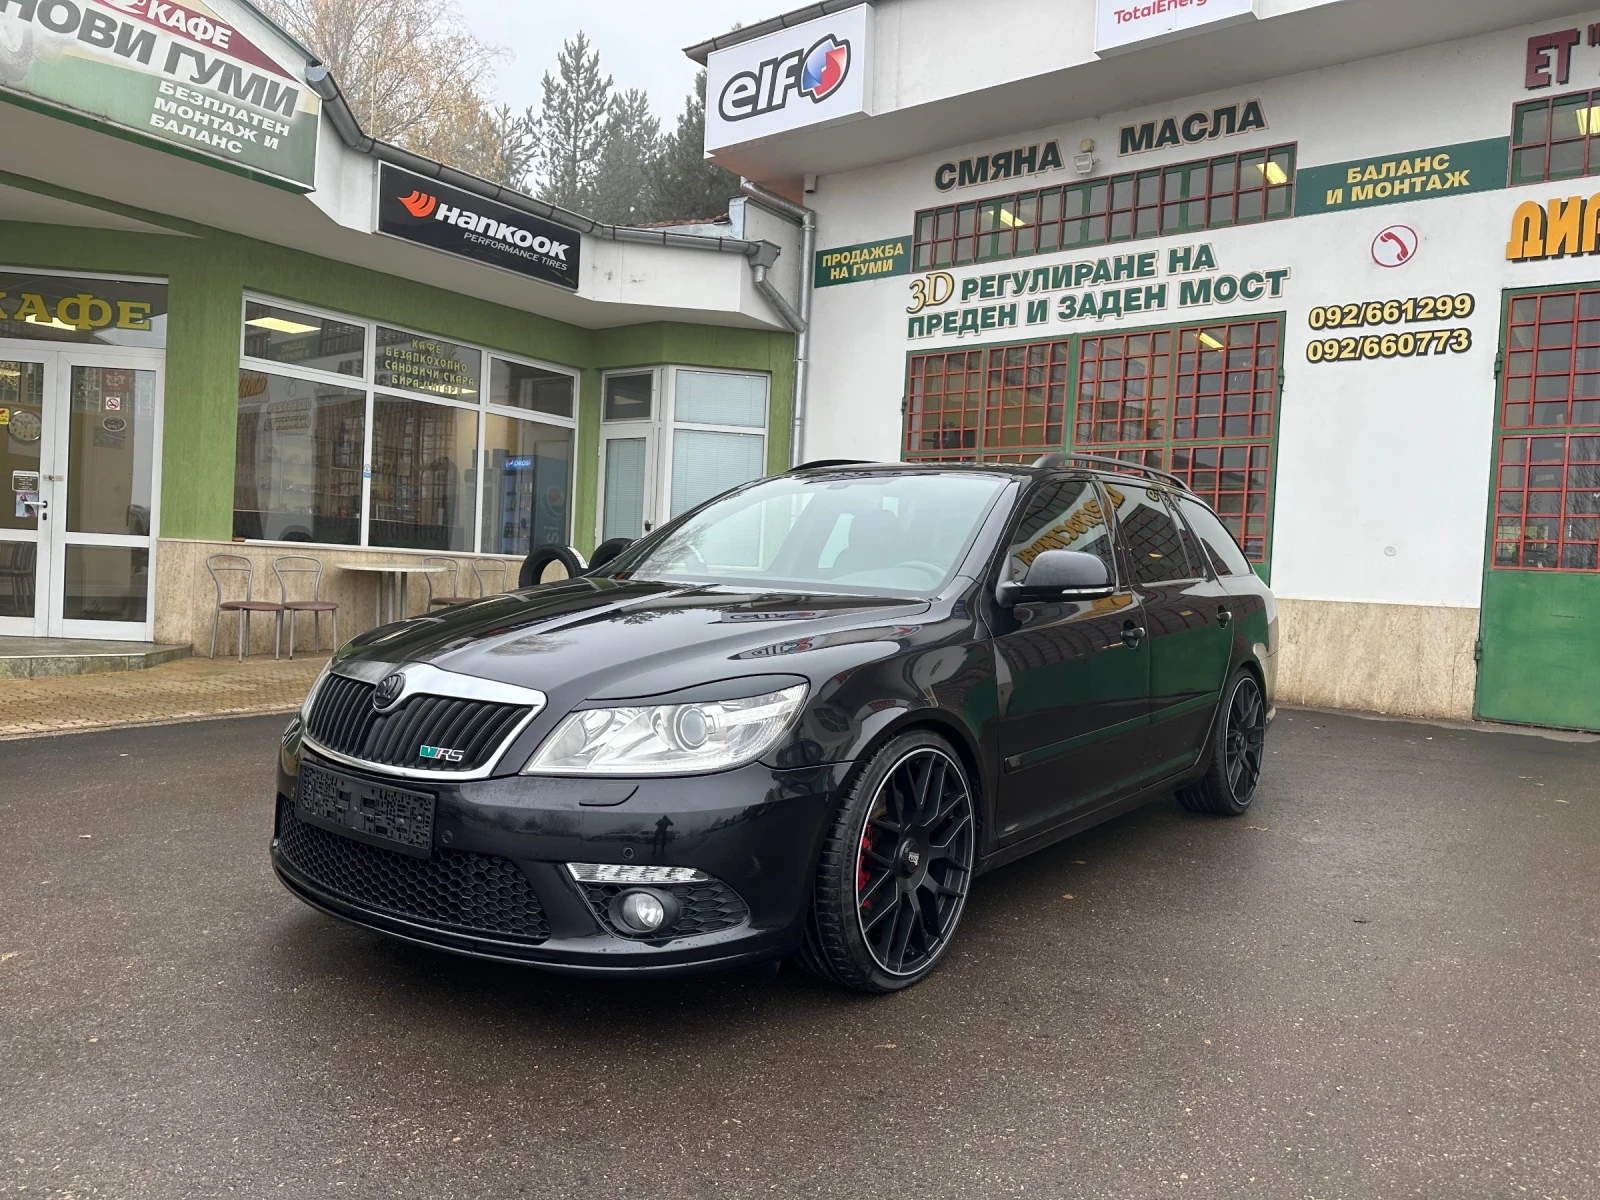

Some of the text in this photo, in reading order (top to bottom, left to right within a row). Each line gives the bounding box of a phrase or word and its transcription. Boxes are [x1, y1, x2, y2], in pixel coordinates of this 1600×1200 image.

[147, 0, 231, 49] КАФЕ
[163, 41, 299, 118] ГУМИ
[719, 48, 804, 121] elf
[154, 97, 279, 149] МОНТАЖ И
[159, 81, 290, 136] БЕЗПЛАТЕН
[150, 114, 242, 153] БАЛАНС
[934, 99, 1268, 192] СМЯНА МАСЛА
[1326, 169, 1470, 205] И МОНТАЖ
[1347, 153, 1450, 184] БАЛАНС
[463, 232, 567, 271] PERFORMANCE TIRES
[822, 242, 904, 267] ПРОДАЖБА
[830, 259, 893, 280] НА ГУМИ
[906, 243, 1218, 314] 3D РЕГУЛИРАНЕ НА
[0, 292, 151, 331] АФЕ
[907, 267, 1291, 340] ПРЕДЕН И ЗАДЕН МОСТ
[1309, 292, 1475, 330] 092/661299
[412, 339, 441, 354] КАФЕ
[1306, 328, 1472, 364] 092/660773
